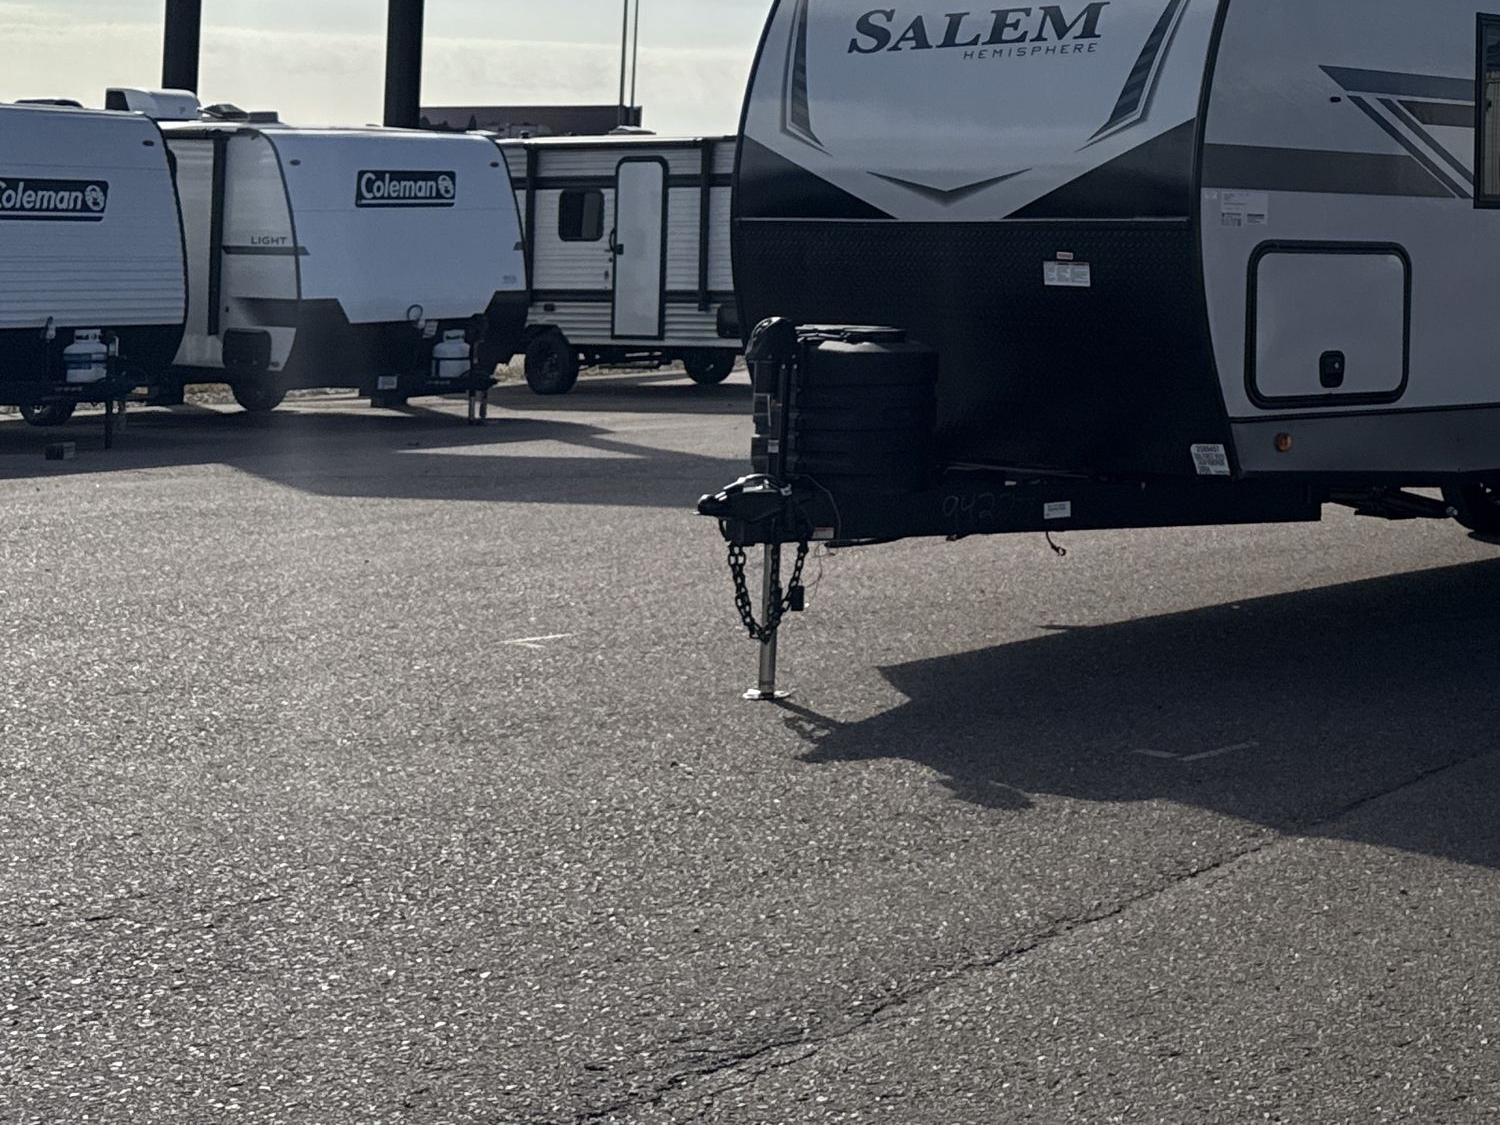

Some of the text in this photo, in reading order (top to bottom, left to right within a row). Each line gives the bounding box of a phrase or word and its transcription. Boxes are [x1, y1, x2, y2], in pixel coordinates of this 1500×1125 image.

[847, 1, 1111, 54] SALEM
[962, 42, 1099, 60] HEMISPHERE
[361, 172, 437, 199] Coleman
[250, 235, 288, 245] LIGHT
